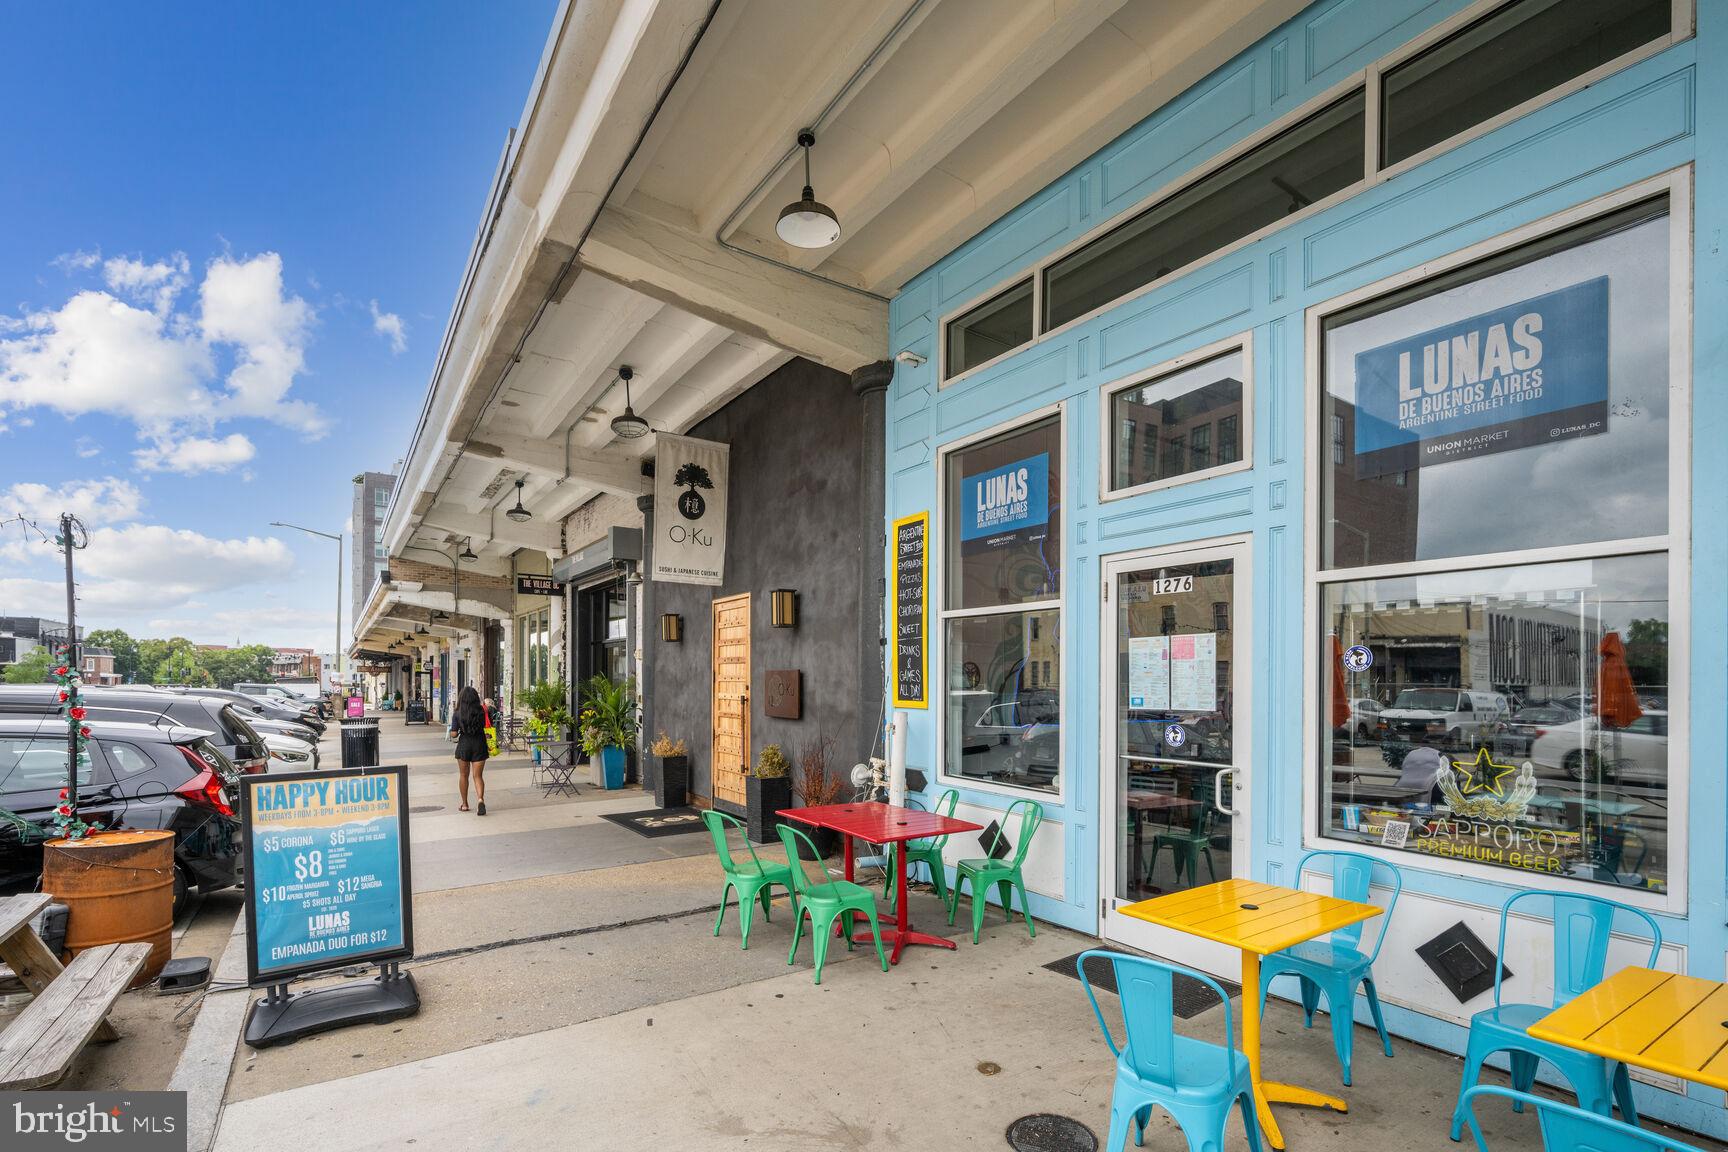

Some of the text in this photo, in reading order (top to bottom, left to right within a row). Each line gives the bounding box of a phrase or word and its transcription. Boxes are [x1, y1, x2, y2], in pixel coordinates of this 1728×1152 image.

[1400, 313, 1542, 402] LUNAS
[1400, 368, 1542, 420] DE BUENOS AIRES
[1399, 387, 1542, 429] ARGENTINE STREET FOOD
[1427, 430, 1509, 453] UNION MARKET
[977, 468, 1028, 512] LUNAS
[977, 501, 1027, 523] DE BUENOS AIRES
[1016, 512, 1027, 520] FOOD
[669, 525, 712, 546] O-Ku
[533, 580, 551, 588] VILLAGE
[1155, 577, 1191, 593] 1276
[899, 644, 920, 657] DRINKS
[900, 669, 921, 682] GAMES
[257, 776, 389, 811] HAPPY HOUR
[258, 811, 292, 822] WEEKDAYS
[293, 809, 312, 819] FROM
[341, 804, 369, 814] WEEKEND
[264, 835, 313, 853] $5 CORONA
[330, 829, 345, 846] $6
[1416, 818, 1557, 854] SAPPORO
[1417, 838, 1560, 872] PREMIUM BEER
[294, 850, 322, 882] $8
[338, 877, 359, 894] $12
[361, 874, 375, 882] MEGA
[361, 880, 382, 890] SANGRIA
[262, 886, 286, 904] $10
[303, 893, 356, 908] $5 SHOTS ALL DAY
[308, 911, 349, 930] LUNAS
[272, 929, 387, 960] EMPANADA DUO FOR $12
